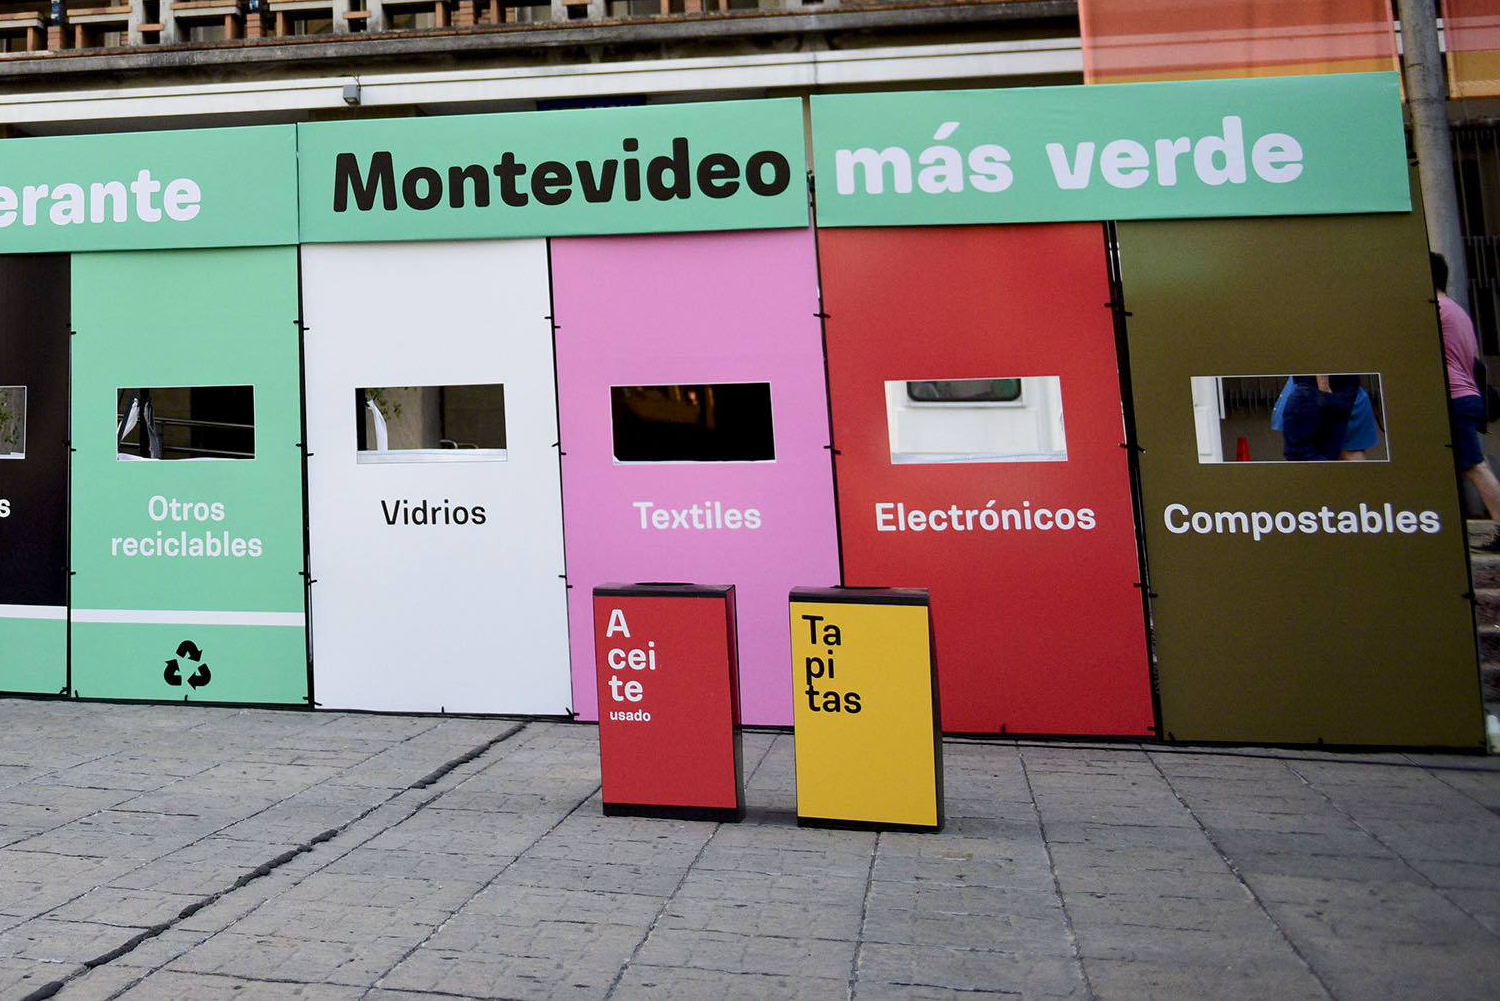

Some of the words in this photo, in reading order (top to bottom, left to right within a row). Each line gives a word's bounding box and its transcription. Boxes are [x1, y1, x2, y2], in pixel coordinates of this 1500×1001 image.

[332, 136, 792, 213] Montevideo
[835, 122, 1015, 196] más
[1045, 115, 1305, 190] verde
[147, 495, 227, 523] Otros
[381, 498, 487, 527] Vidrios
[633, 501, 762, 531] Textiles
[875, 499, 1097, 532] Electrónicos
[1163, 503, 1441, 541] Compostables
[110, 527, 263, 560] reciclables
[606, 608, 631, 639] A
[801, 614, 843, 647] Ta
[607, 641, 657, 671] cei
[804, 648, 836, 687] pi
[608, 673, 644, 703] te
[804, 683, 864, 715] tas
[609, 708, 651, 722] usado
